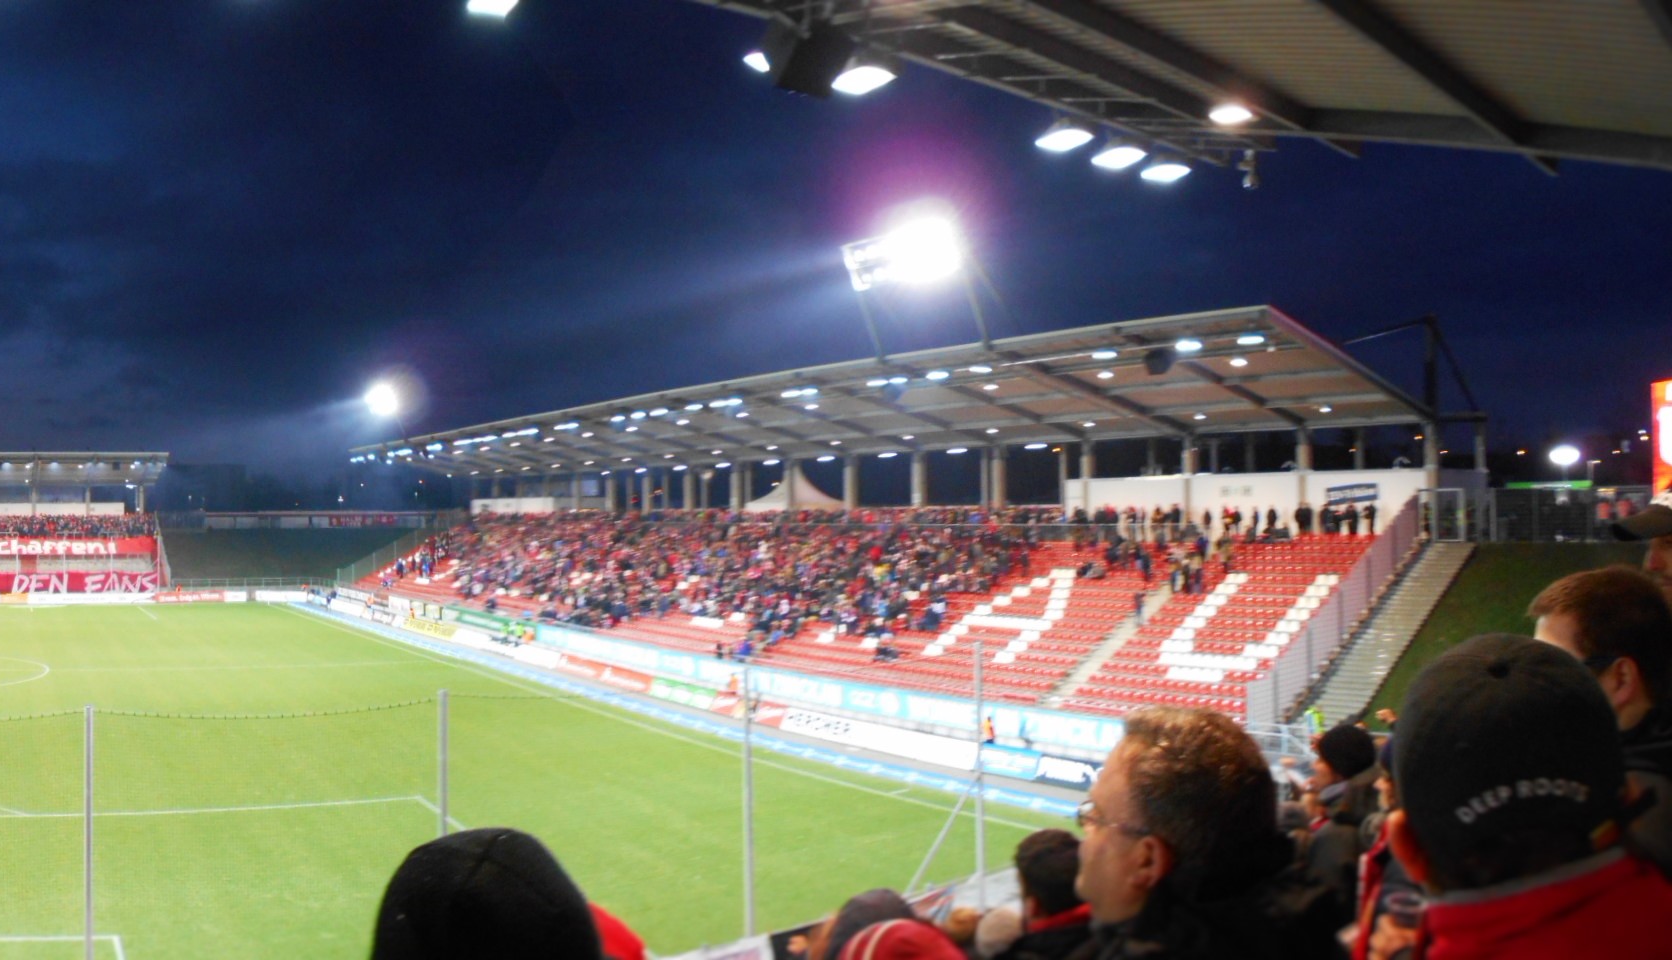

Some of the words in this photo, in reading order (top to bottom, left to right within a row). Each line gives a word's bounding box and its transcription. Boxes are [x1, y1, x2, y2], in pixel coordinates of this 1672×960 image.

[11, 573, 68, 595] DEN
[84, 573, 158, 595] FANS
[1454, 785, 1512, 824] DEEP
